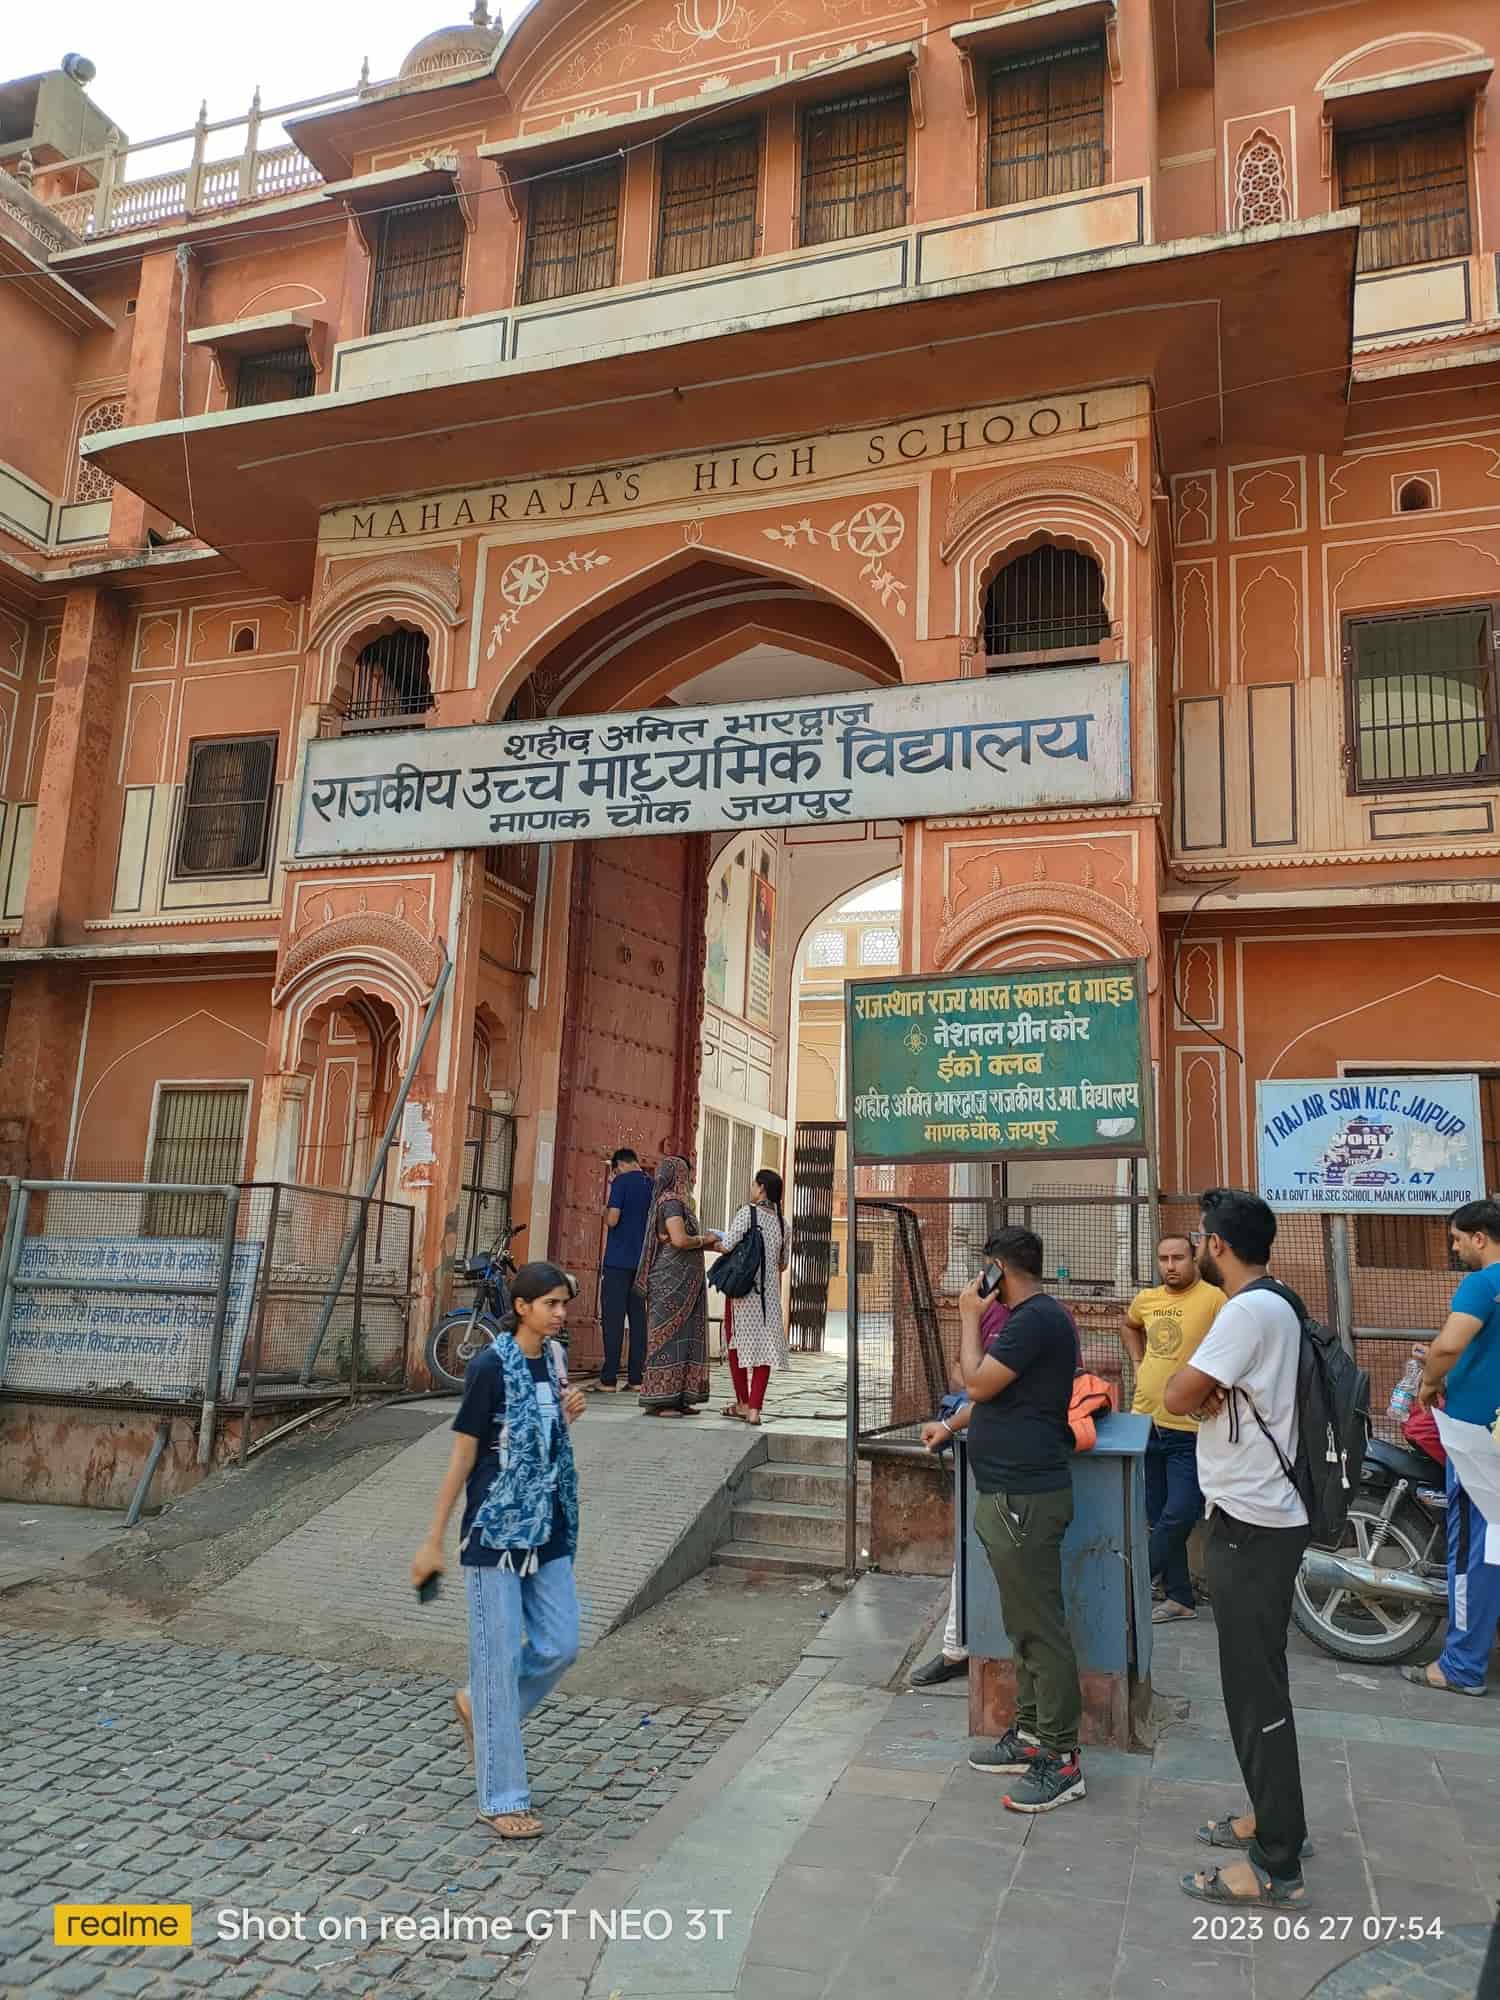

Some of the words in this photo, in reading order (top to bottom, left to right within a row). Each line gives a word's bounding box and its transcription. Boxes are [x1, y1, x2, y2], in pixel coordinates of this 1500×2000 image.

[693, 446, 818, 493] HIGH
[866, 400, 1100, 465] SCHOOL
[504, 726, 594, 761] शहीद
[599, 716, 710, 751] अमित
[312, 763, 463, 823] राजकीय
[463, 760, 571, 809] उच्च
[835, 713, 1096, 780] विद्यालय
[489, 808, 591, 834] माणक
[721, 788, 854, 821] जयपुर
[855, 990, 926, 1019] राजस्थान
[928, 987, 968, 1014] राज्य
[969, 984, 1010, 1012] भारत
[1068, 980, 1082, 1006] व
[1084, 976, 1134, 1008] गाइड
[933, 1018, 1005, 1049] नेशनल
[1007, 1012, 1048, 1047] ग्रीन
[987, 1052, 1045, 1077] क्लब
[854, 1085, 891, 1122] शहीद
[891, 1085, 932, 1118] अमित
[989, 1082, 1045, 1114] राजकीय
[1079, 1078, 1140, 1112] विद्यालय
[1272, 1104, 1304, 1140] RAJ
[1302, 1093, 1328, 1122] AIR
[1402, 1095, 1466, 1137] JAIPUR
[924, 1123, 969, 1142] माणक
[1004, 1120, 1061, 1146] जयपुर
[1374, 1189, 1405, 1202] MANAK
[1440, 1189, 1472, 1202] JAIPUR
[1409, 1172, 1436, 1185] 47
[1153, 1307, 1183, 1317] music
